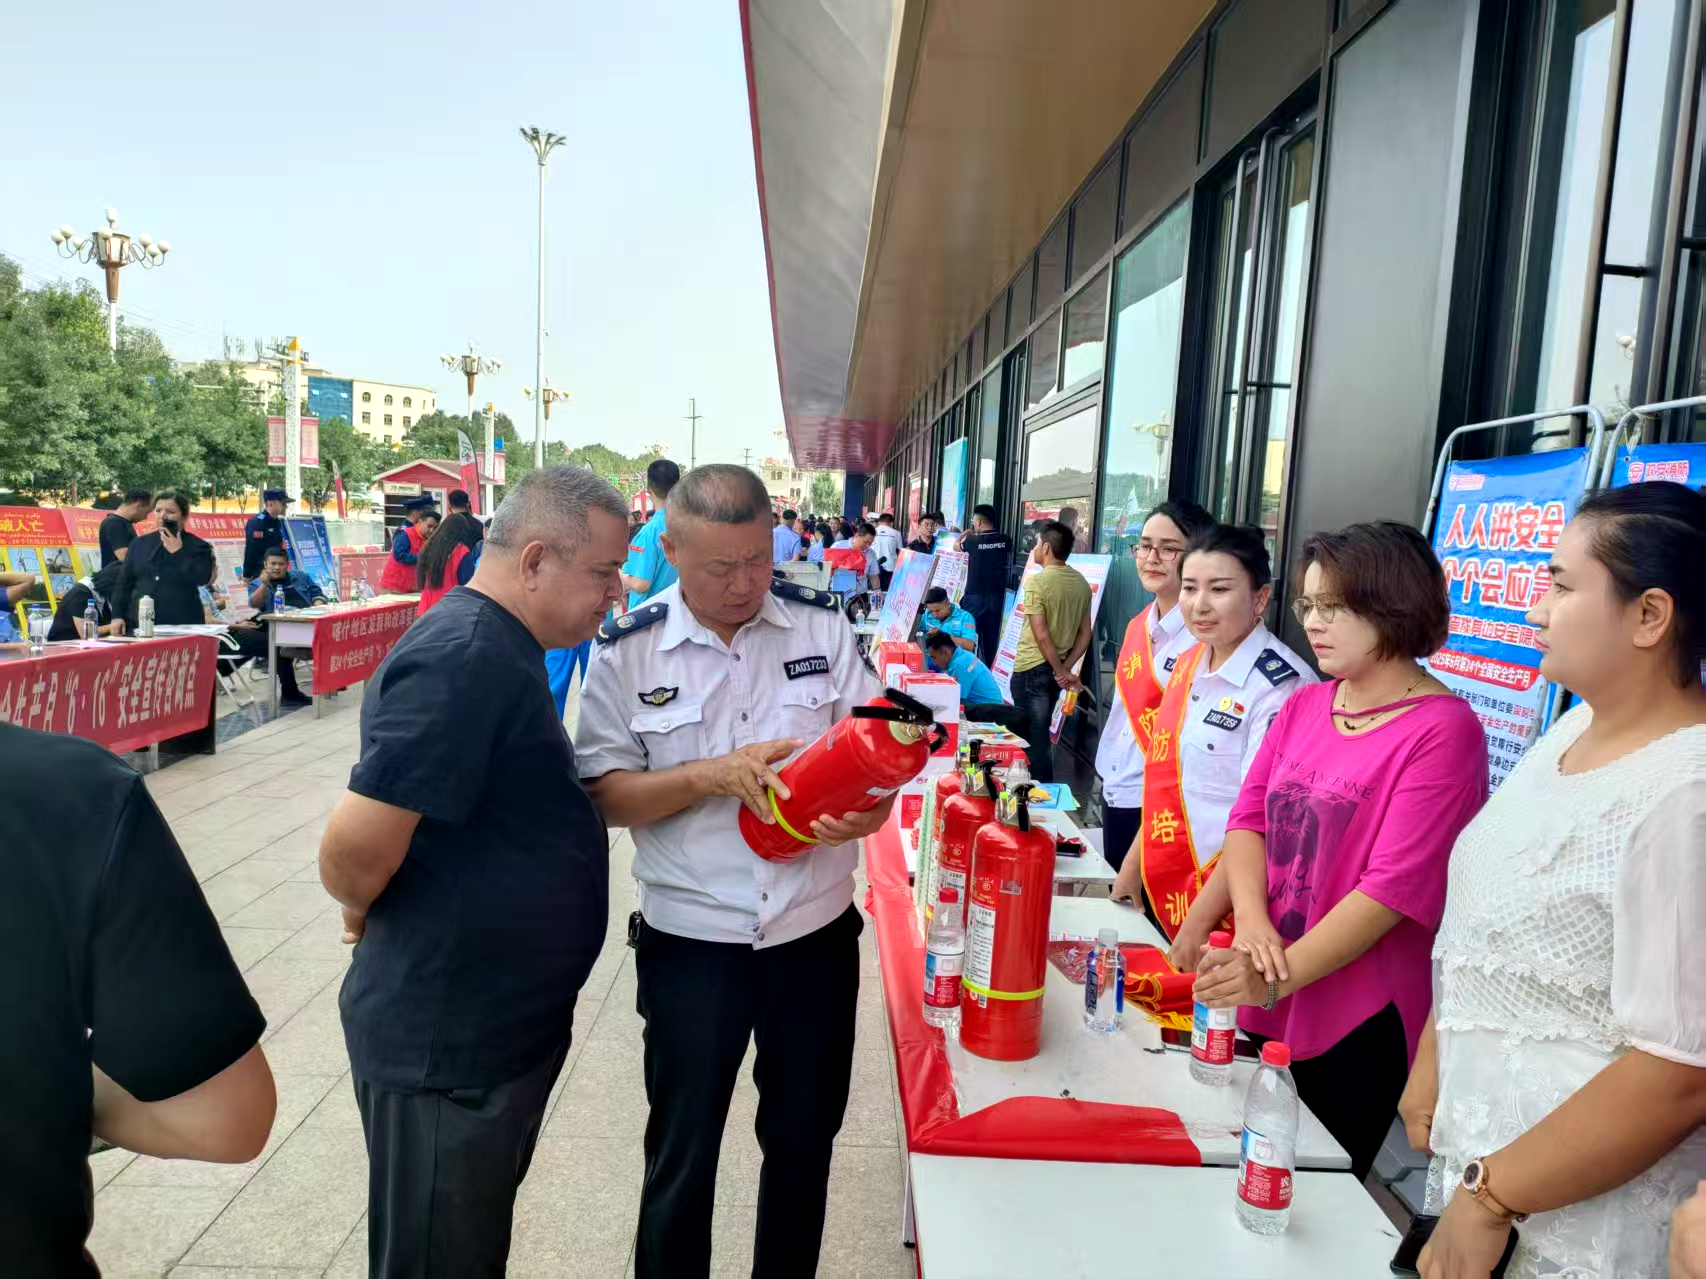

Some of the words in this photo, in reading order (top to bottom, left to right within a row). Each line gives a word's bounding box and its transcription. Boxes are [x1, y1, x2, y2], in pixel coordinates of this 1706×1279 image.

[1443, 501, 1565, 552] 人人讲安全
[977, 542, 1006, 550] SINOPEC
[1449, 613, 1540, 648] 查找身边安全隐
